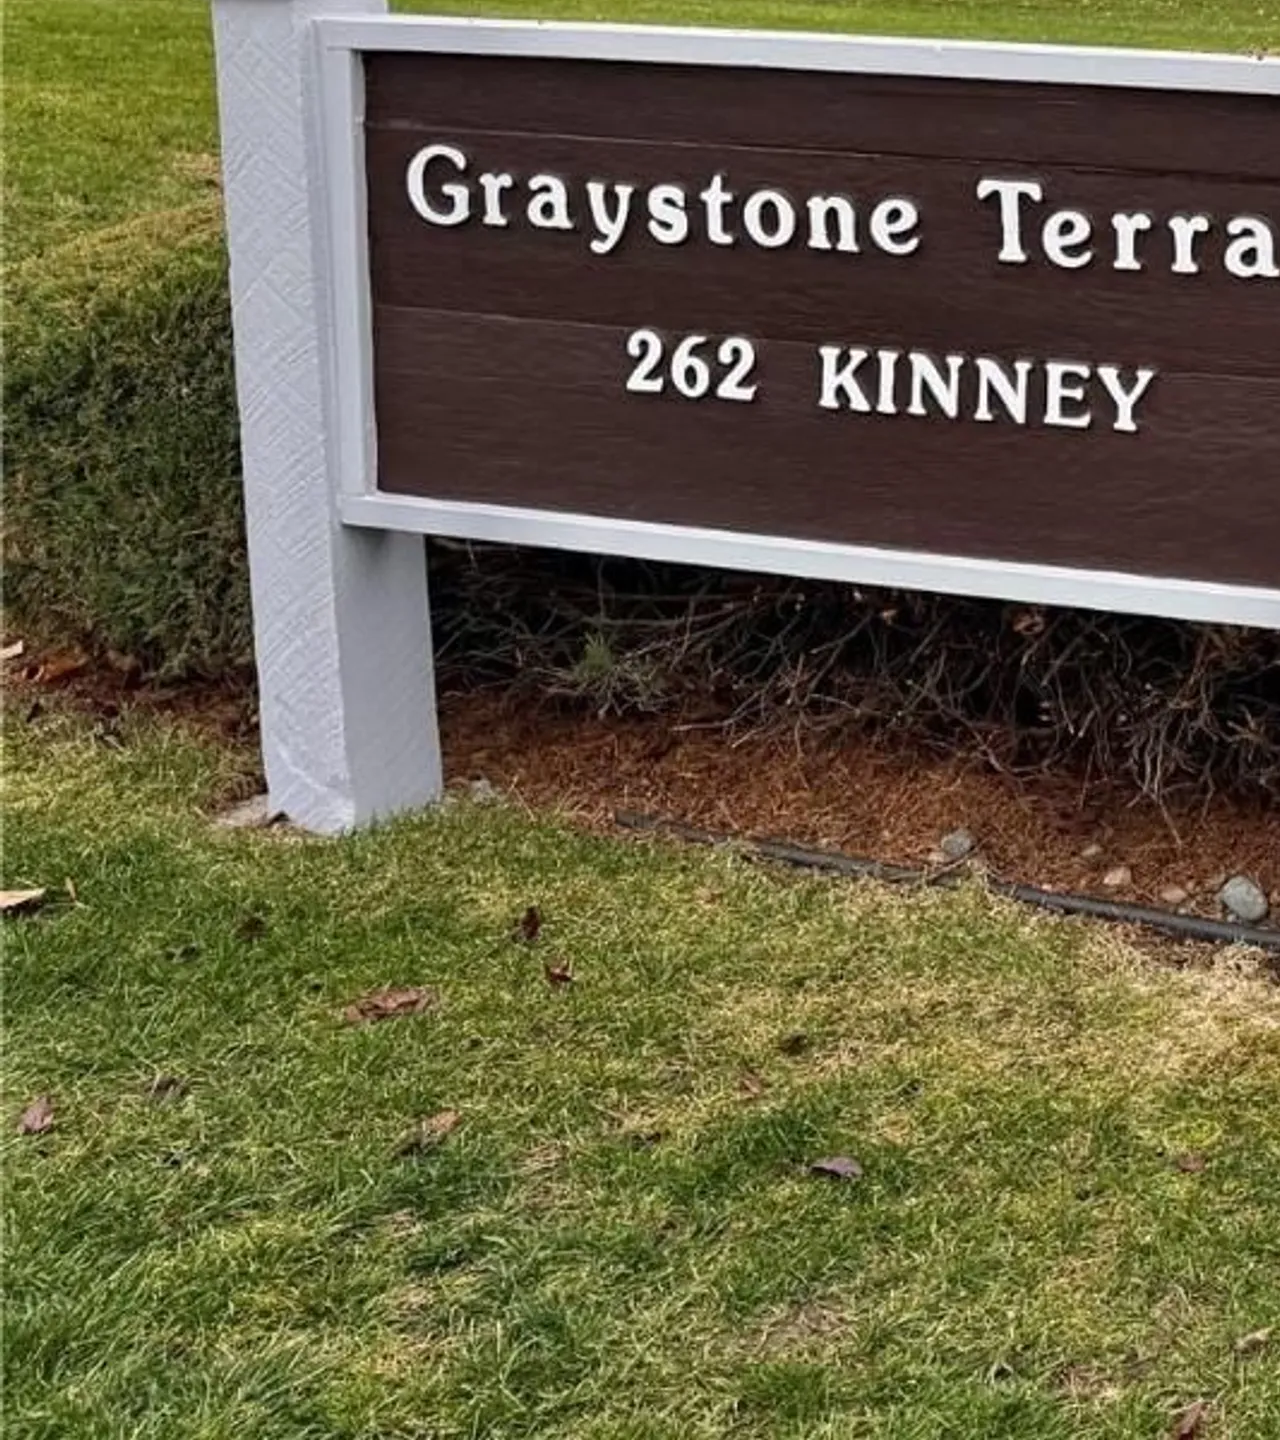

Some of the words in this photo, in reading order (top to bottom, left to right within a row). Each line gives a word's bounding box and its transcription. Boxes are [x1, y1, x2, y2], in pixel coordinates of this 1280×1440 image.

[405, 143, 922, 256] Graystone
[625, 328, 759, 403] 262
[818, 344, 1156, 434] KINNEY
